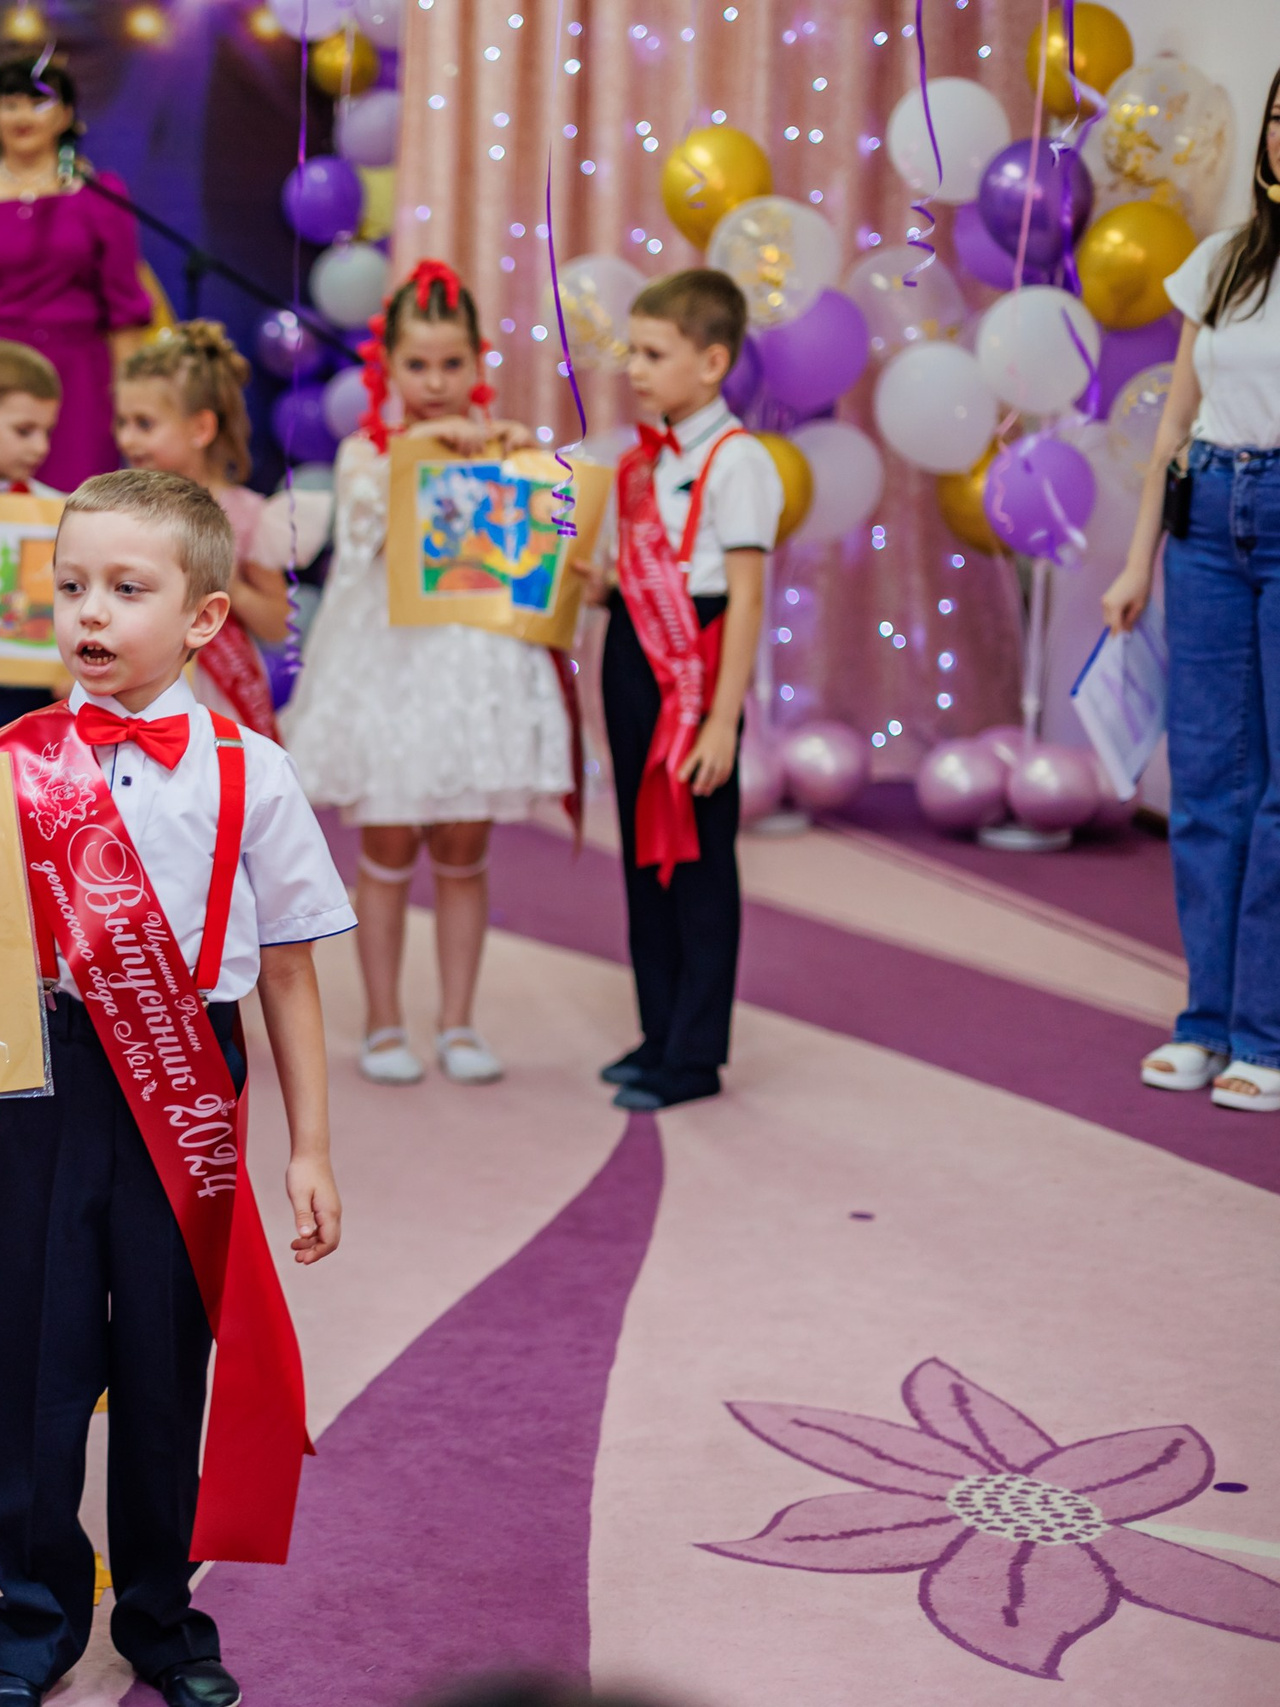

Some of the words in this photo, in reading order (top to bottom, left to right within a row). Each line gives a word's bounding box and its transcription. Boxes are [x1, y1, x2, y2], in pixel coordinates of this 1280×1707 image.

[30, 859, 95, 962] детского
[86, 965, 120, 1017] сада
[67, 823, 197, 1092] Выпускник
[163, 1093, 238, 1198] 2024
[142, 911, 181, 995] Шукшин
[174, 994, 203, 1053] Роман
